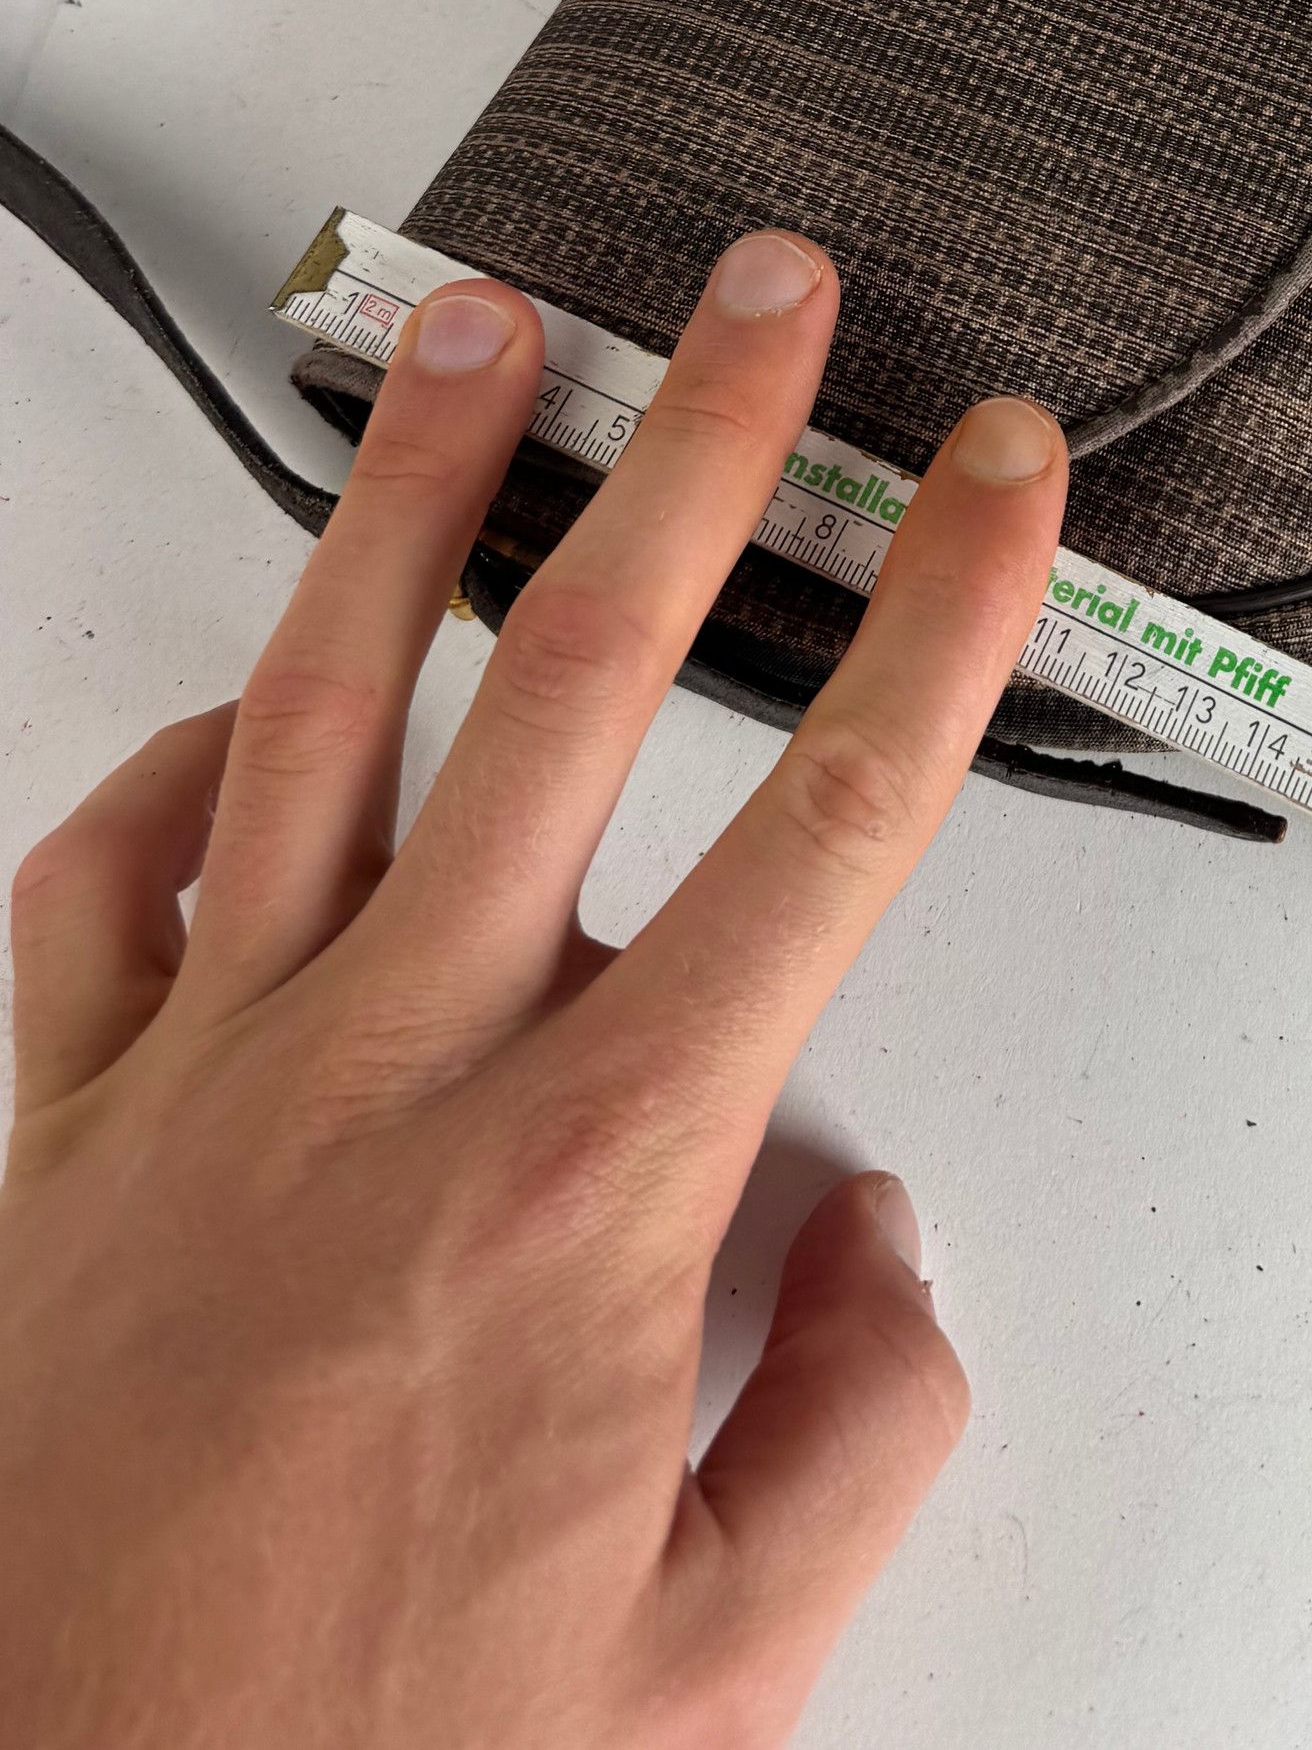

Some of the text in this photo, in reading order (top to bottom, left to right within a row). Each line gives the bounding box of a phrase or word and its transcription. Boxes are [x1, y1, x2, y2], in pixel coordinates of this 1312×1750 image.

[538, 385, 562, 410] 4
[607, 414, 630, 441] 5
[815, 514, 837, 540] 8
[1105, 651, 1147, 692] 12
[1174, 685, 1217, 725] 13
[1248, 720, 1290, 761] 14
[783, 452, 908, 525] nstalla
[1140, 621, 1204, 668] mit
[1207, 645, 1293, 709] Pfiff
